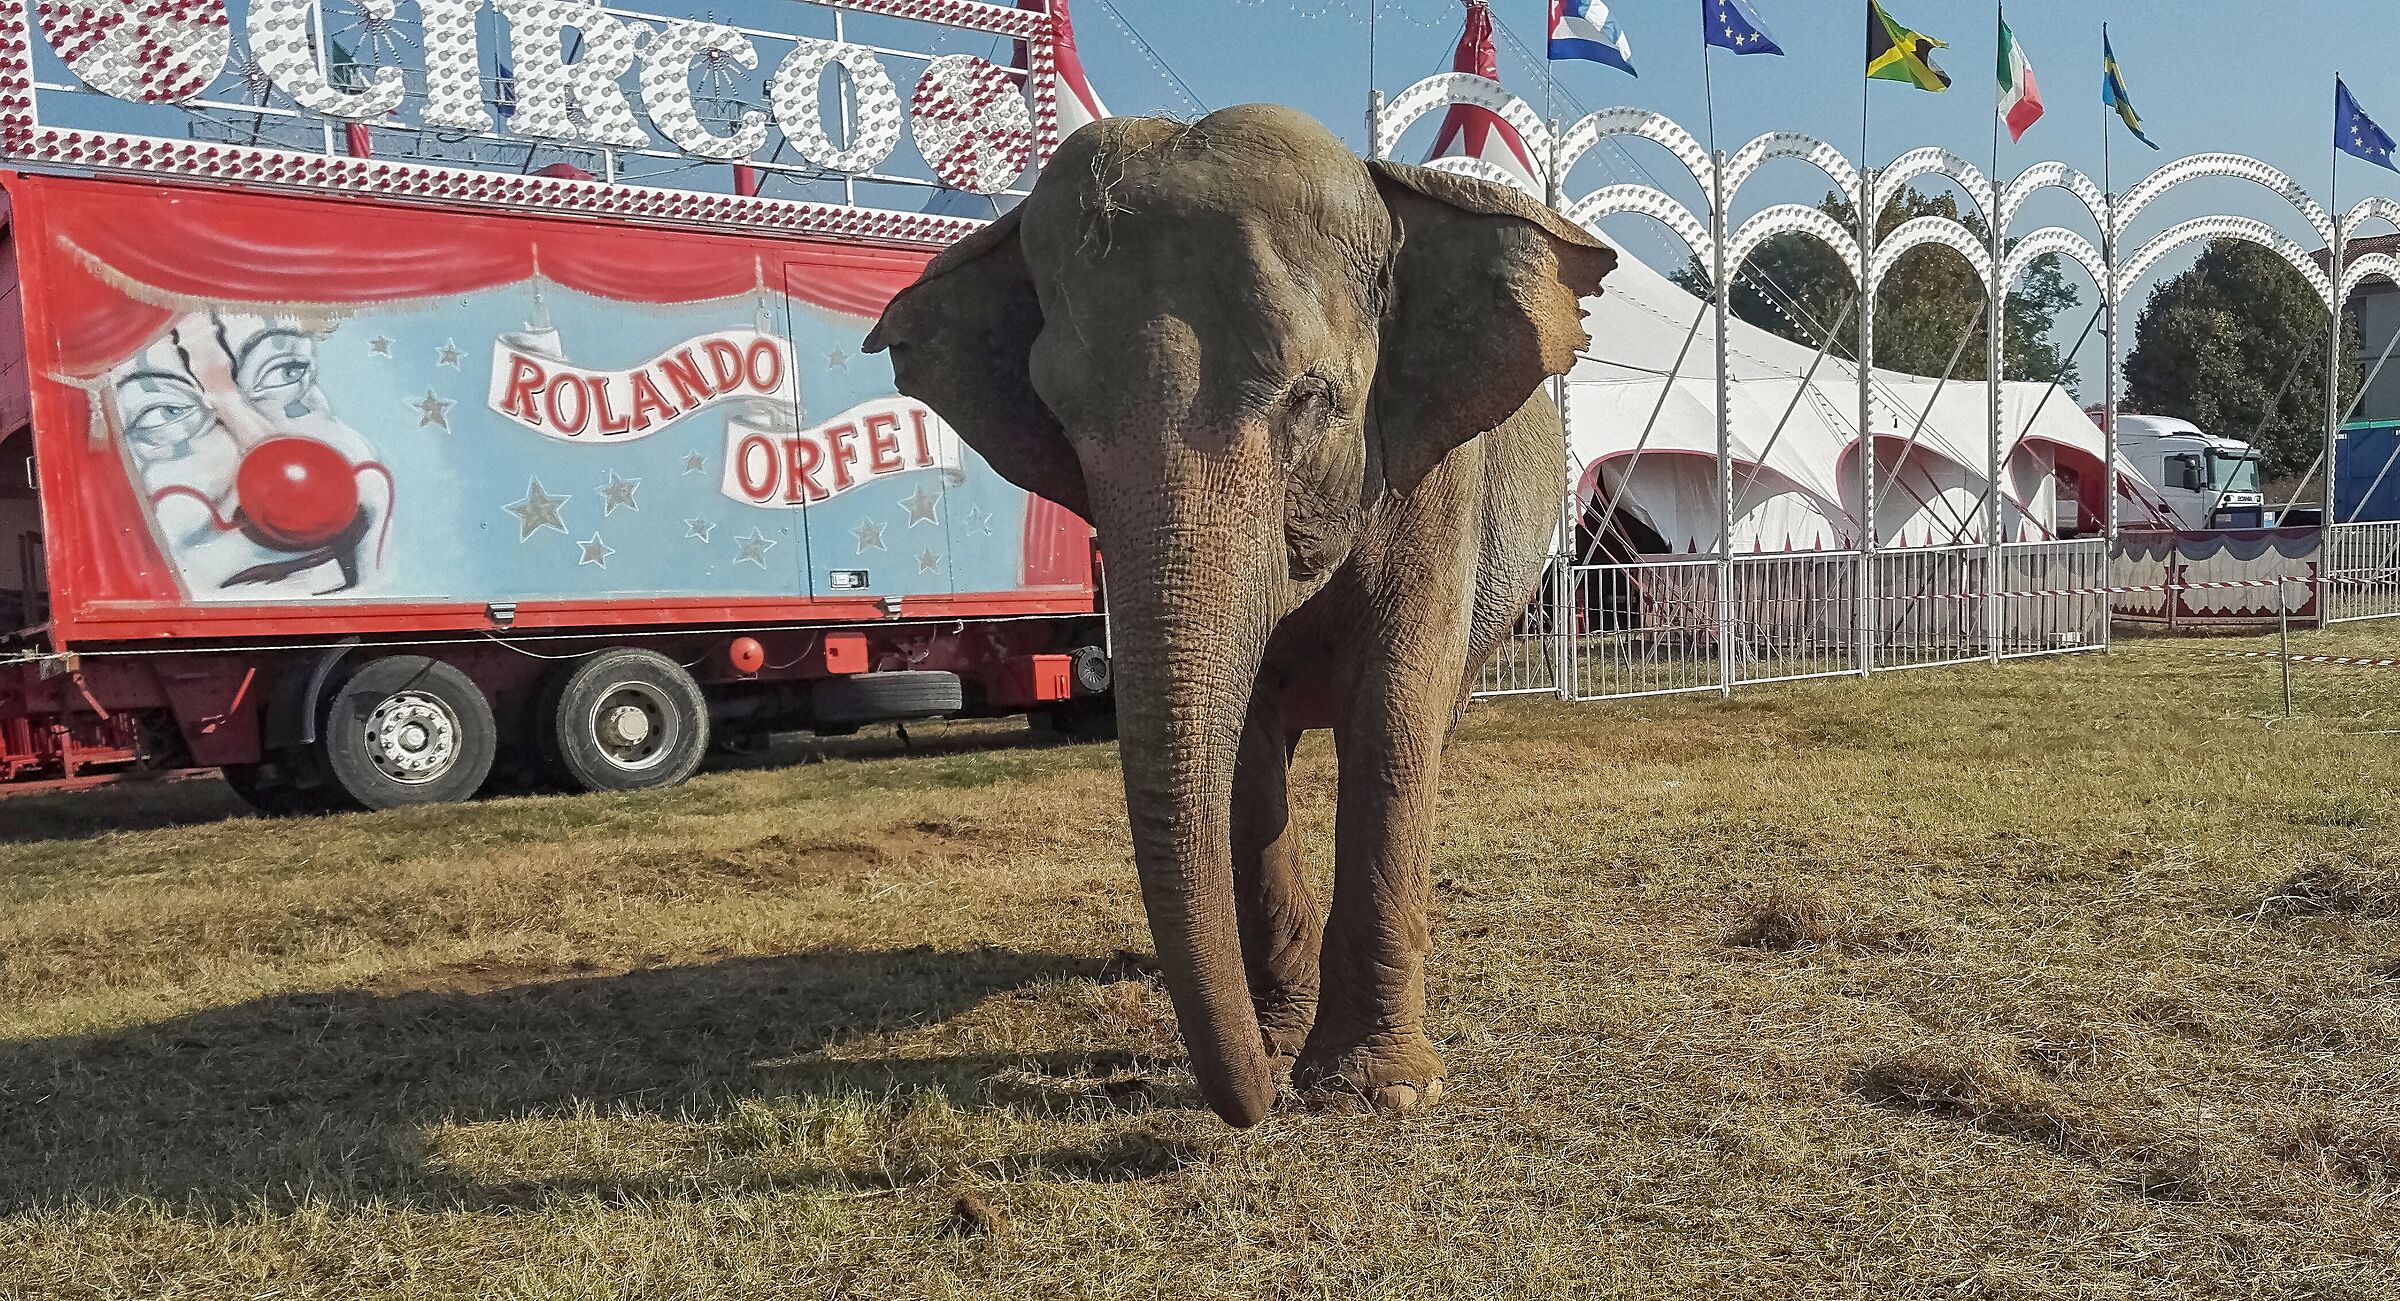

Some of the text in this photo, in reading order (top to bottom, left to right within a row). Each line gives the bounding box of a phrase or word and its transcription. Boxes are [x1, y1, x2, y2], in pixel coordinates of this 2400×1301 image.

[247, 0, 903, 173] CIRCO
[500, 337, 784, 437] ROLANDO
[735, 409, 934, 505] ORFEI
